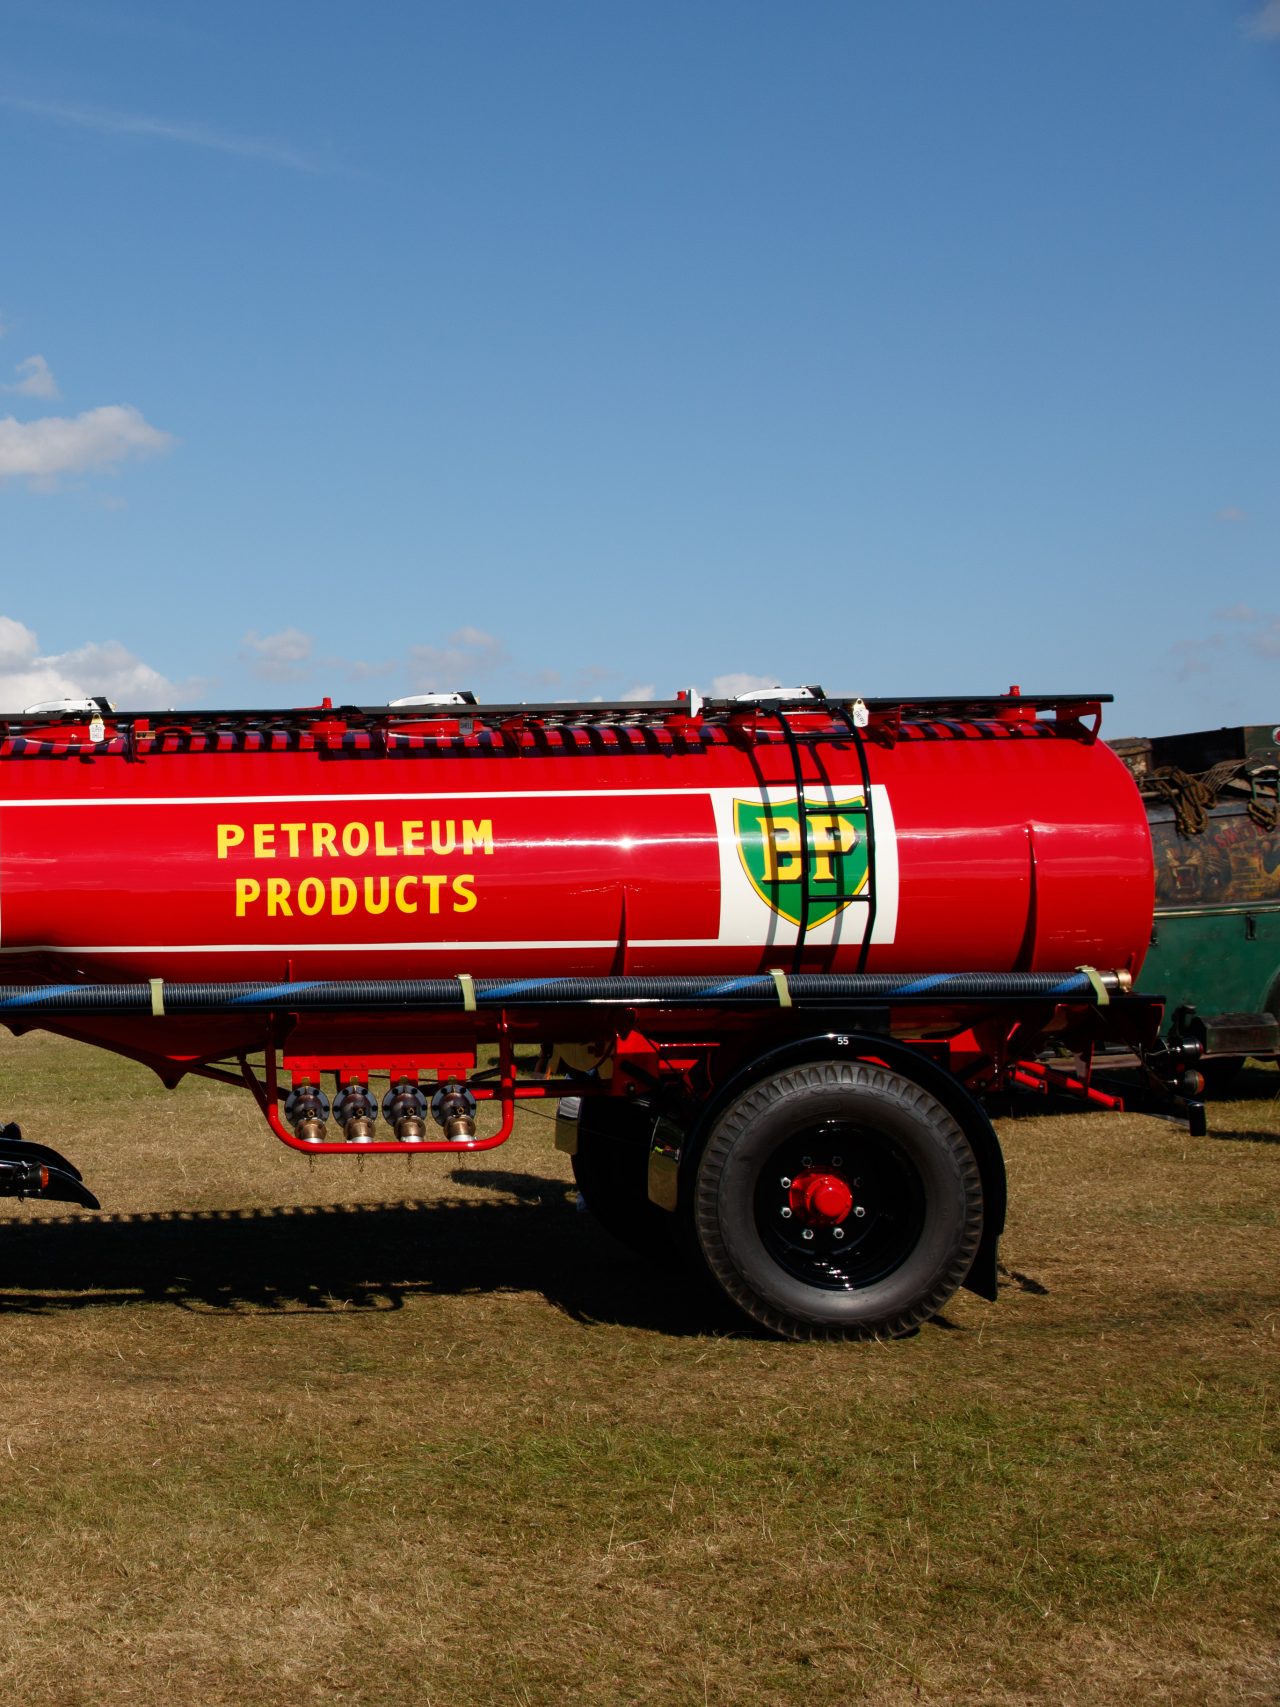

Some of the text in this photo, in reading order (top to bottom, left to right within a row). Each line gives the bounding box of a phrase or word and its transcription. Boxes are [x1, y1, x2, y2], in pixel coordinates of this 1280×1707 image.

[217, 819, 494, 859] PETROLEUM
[755, 815, 860, 884] BP
[235, 874, 478, 917] PRODUCTS
[837, 1036, 849, 1045] 55
